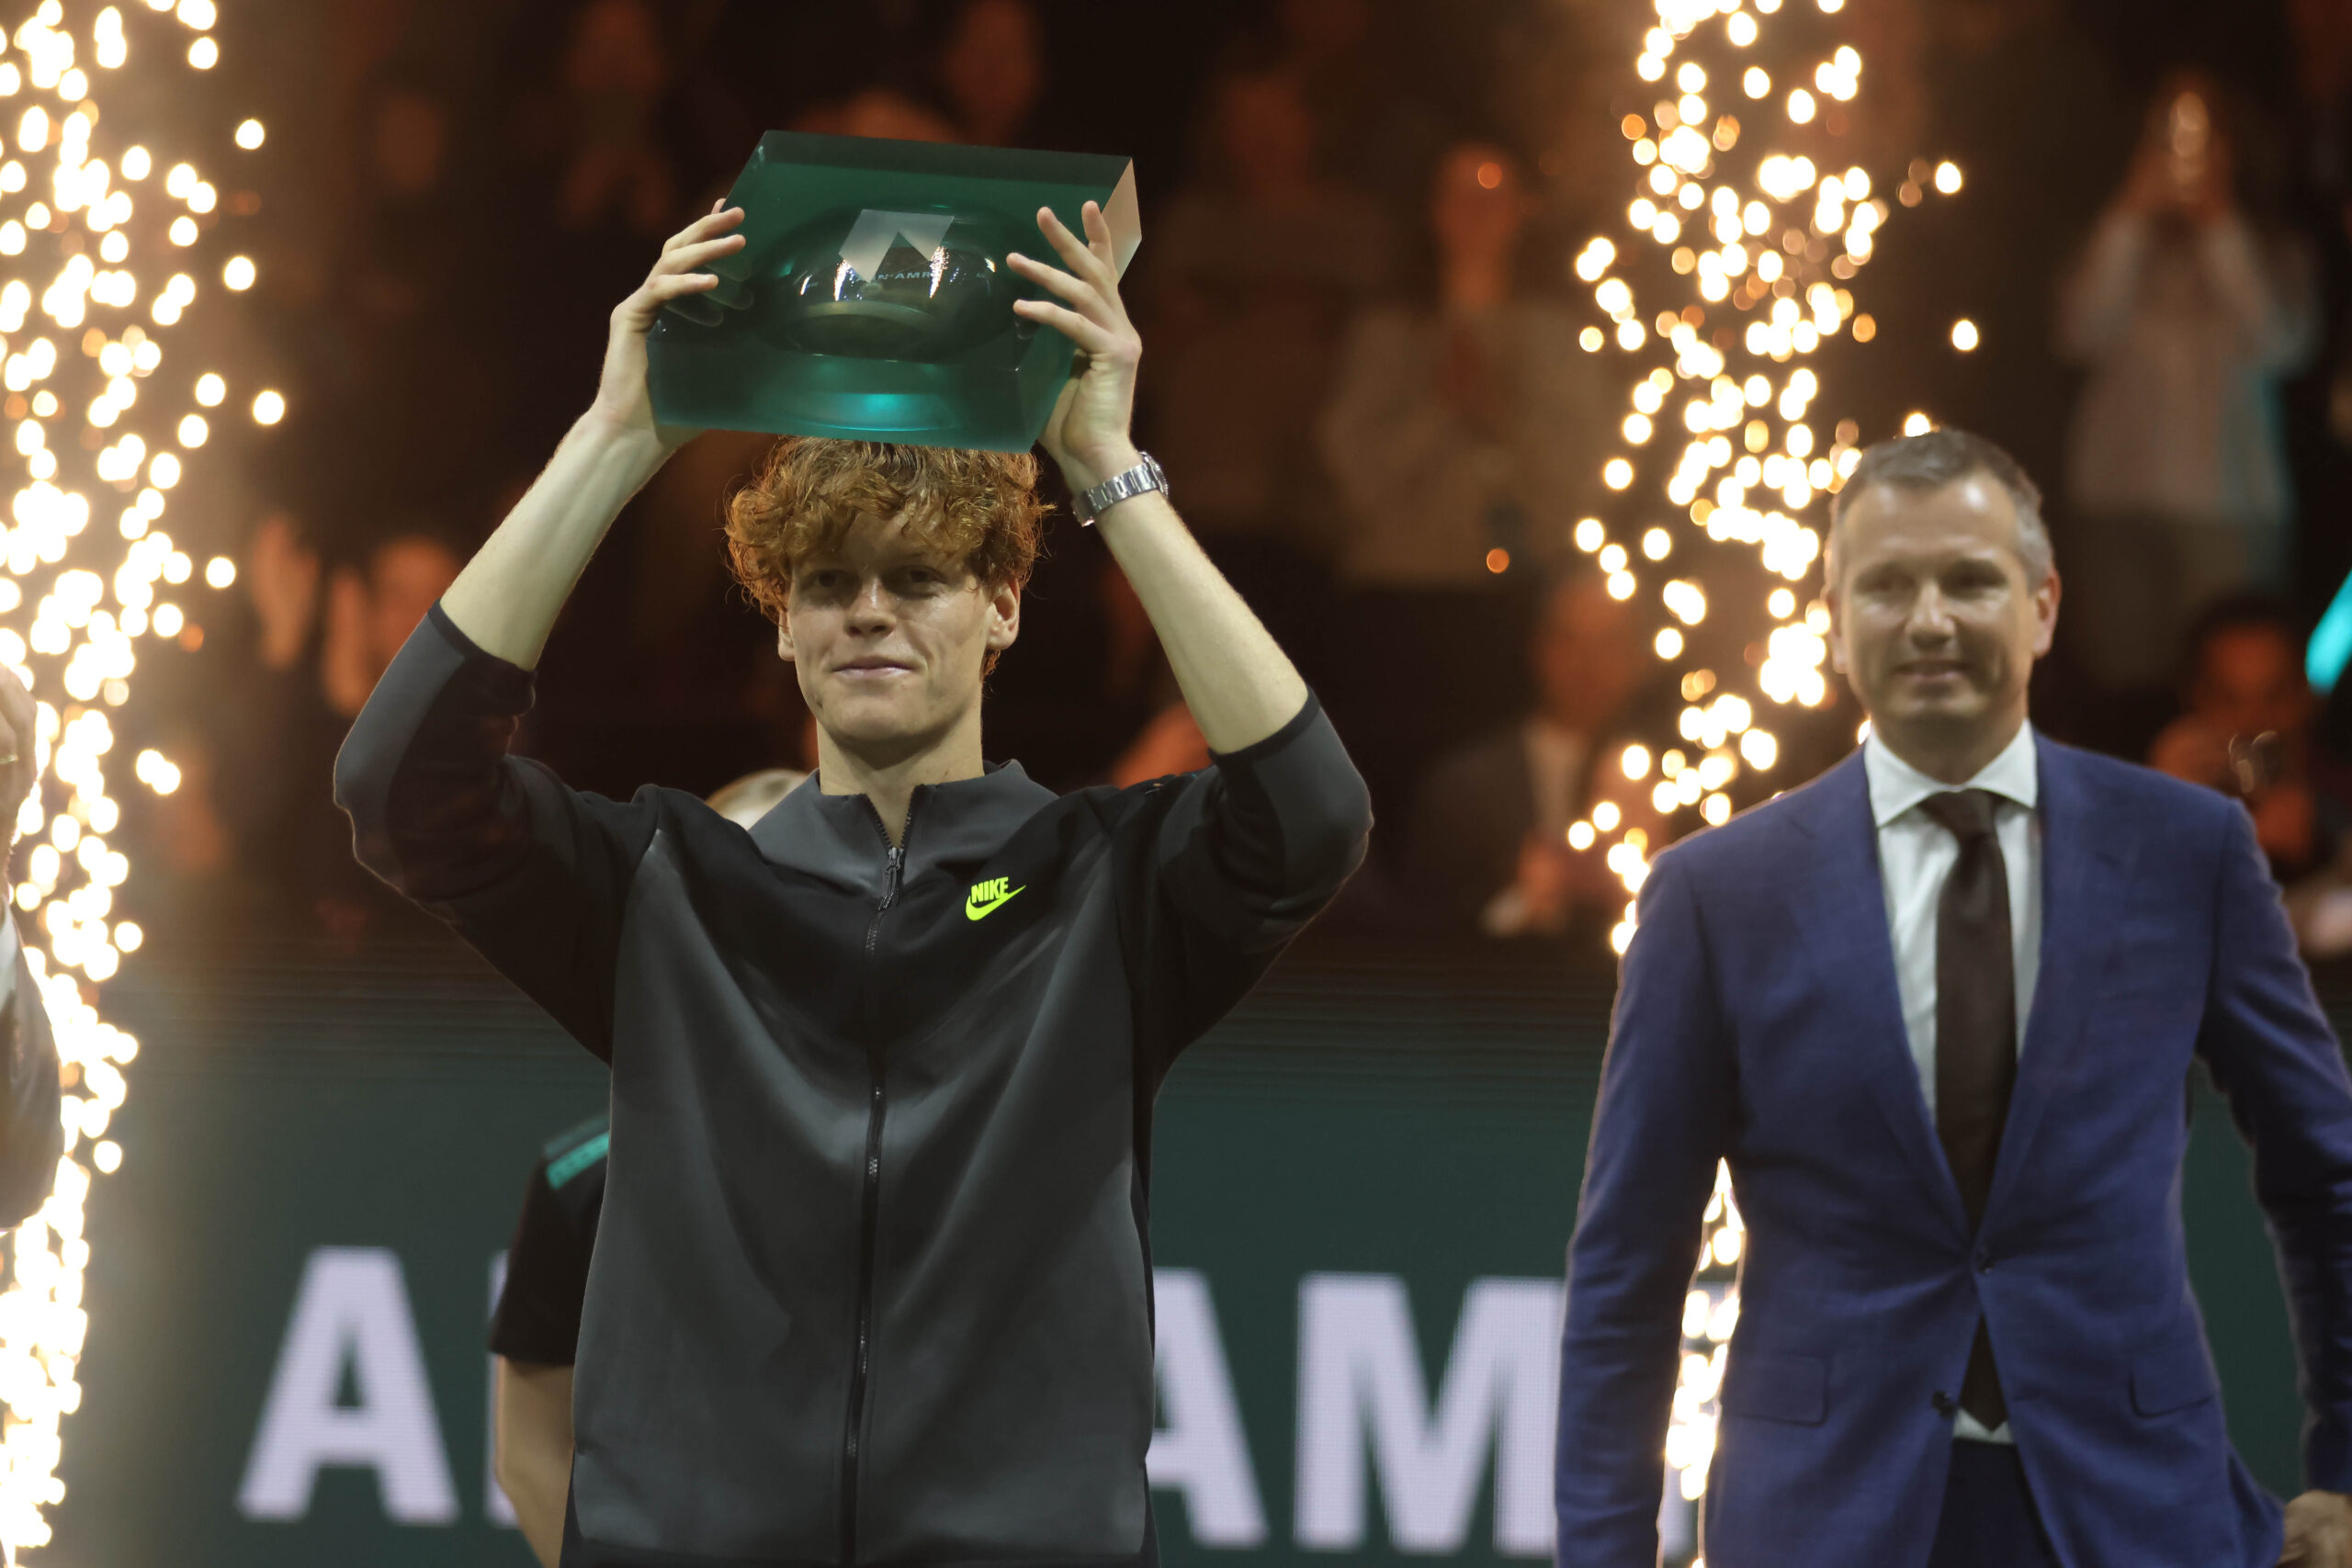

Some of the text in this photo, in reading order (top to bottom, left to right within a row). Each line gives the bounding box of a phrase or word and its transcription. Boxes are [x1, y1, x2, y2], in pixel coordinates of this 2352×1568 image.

[971, 876, 1009, 903] NIKE
[235, 1245, 1562, 1559] A AM
